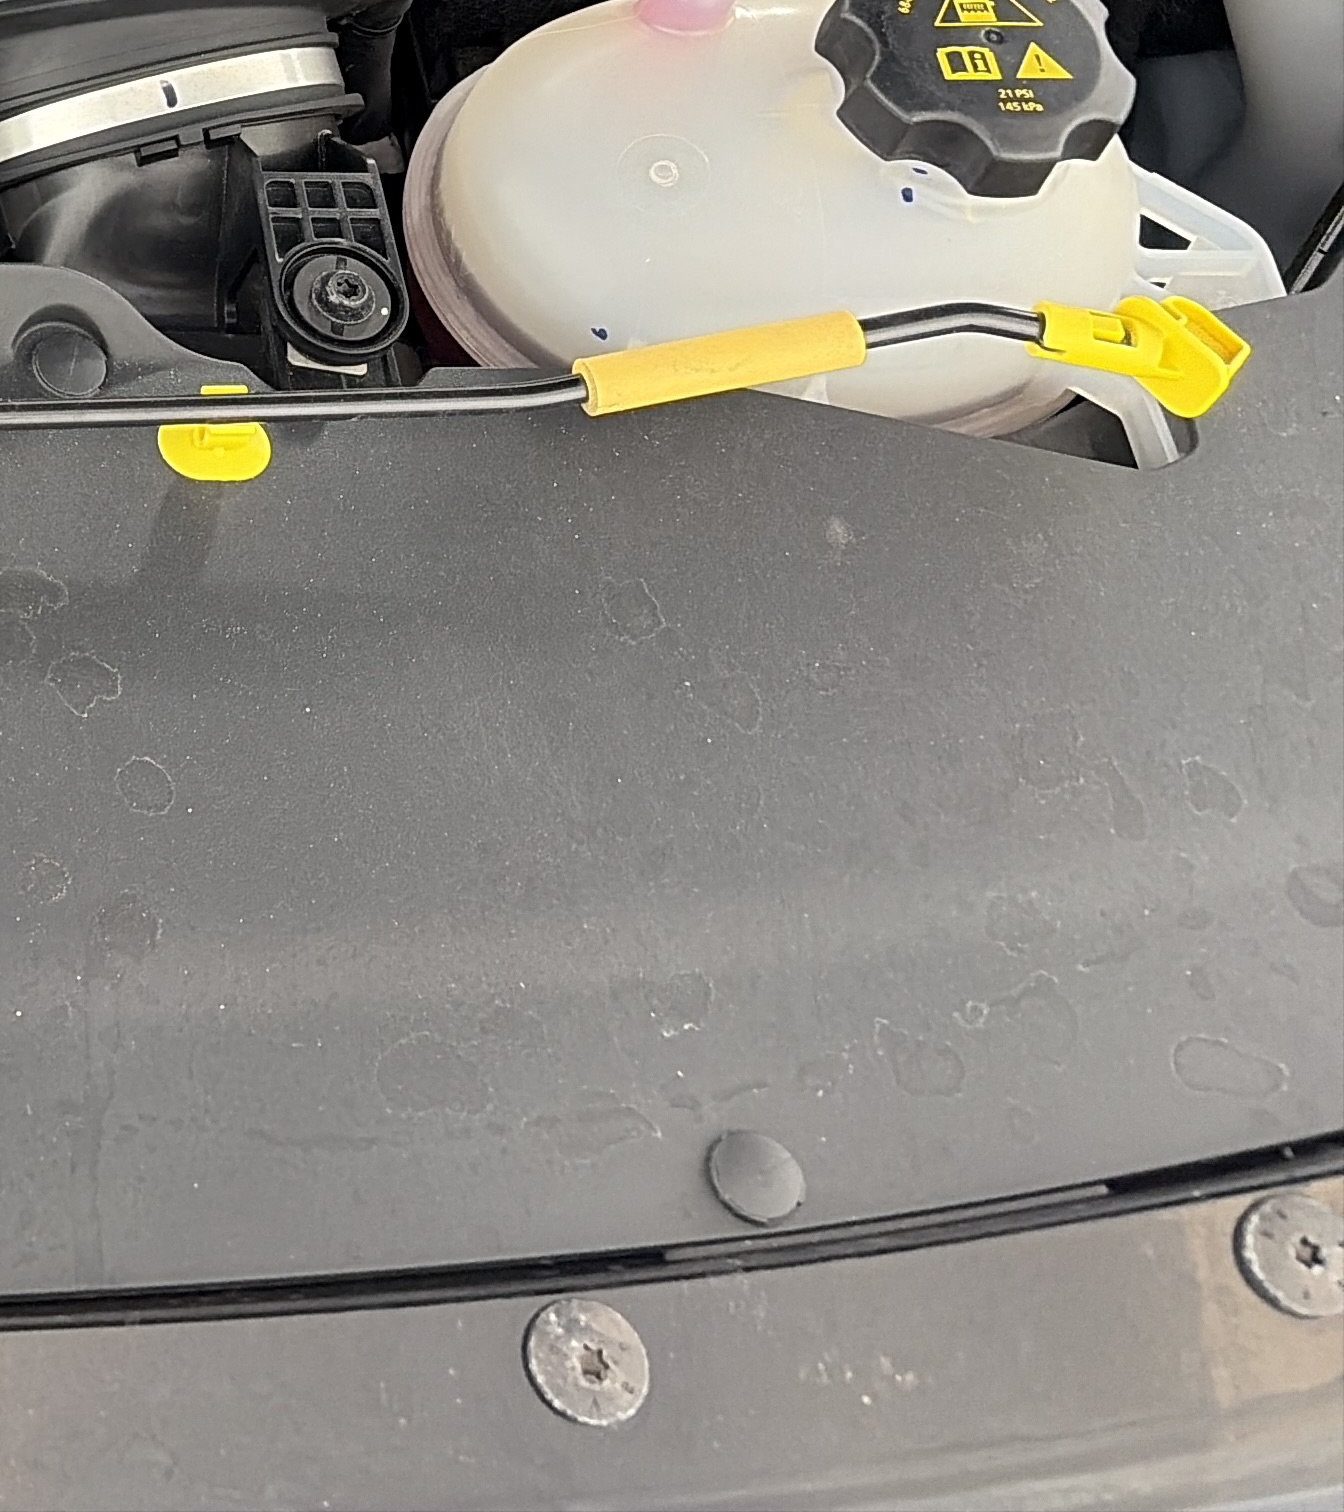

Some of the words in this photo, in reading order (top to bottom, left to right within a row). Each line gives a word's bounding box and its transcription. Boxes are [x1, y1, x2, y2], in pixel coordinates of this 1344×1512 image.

[998, 88, 1012, 99] 21
[1014, 89, 1034, 99] PSI
[998, 101, 1022, 112] 145
[1022, 101, 1045, 113] kPa
